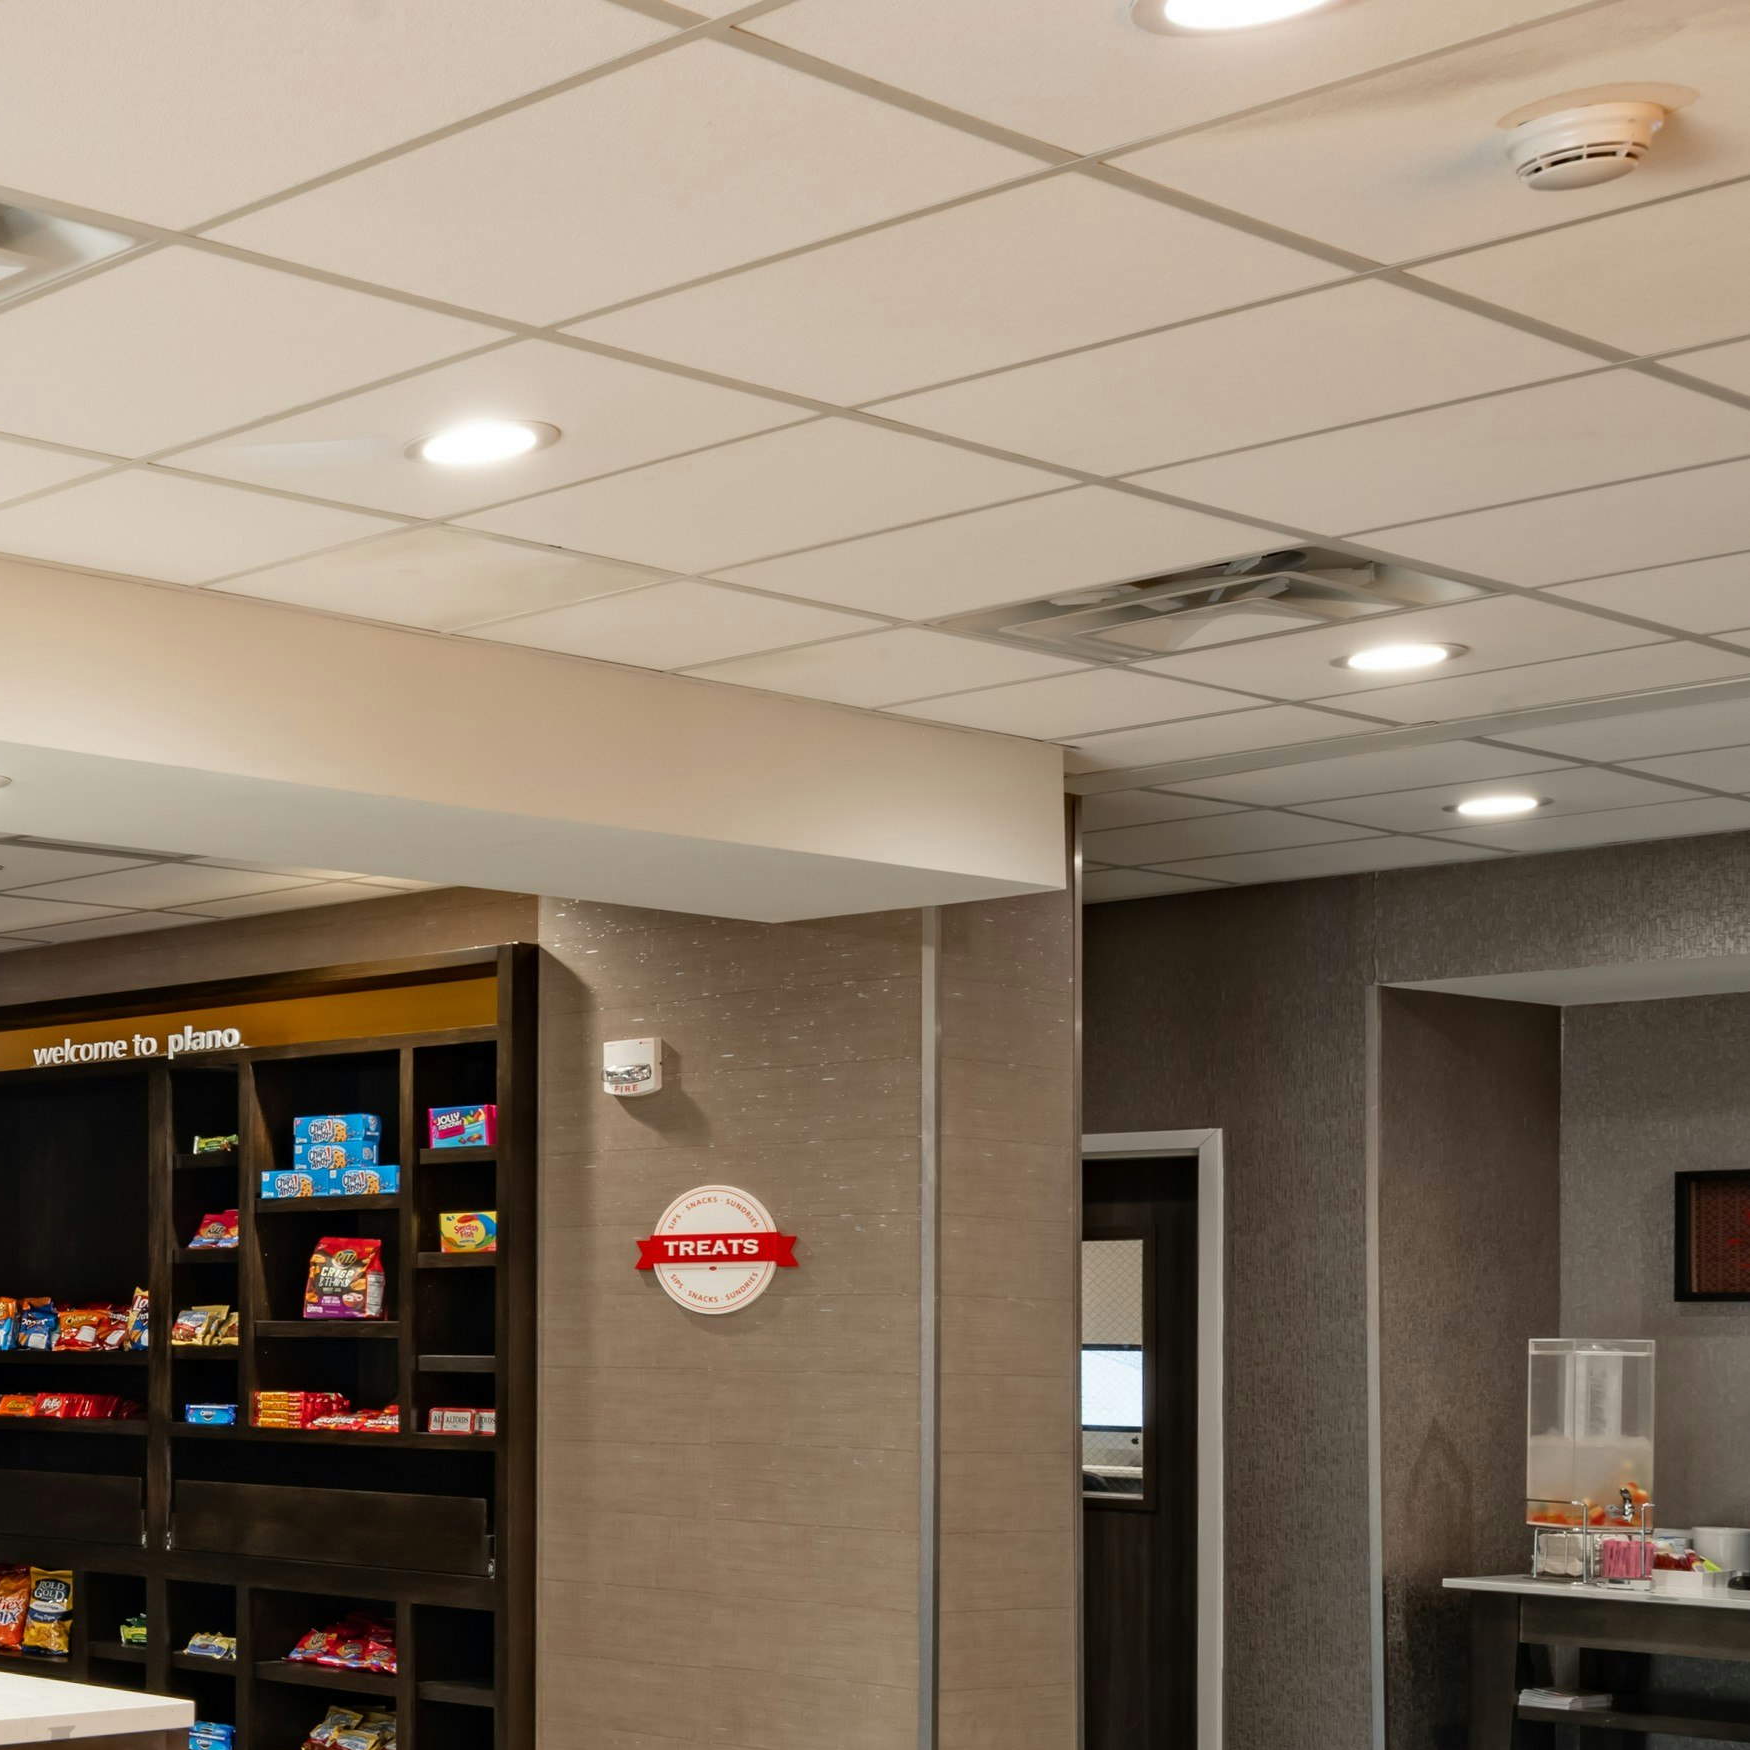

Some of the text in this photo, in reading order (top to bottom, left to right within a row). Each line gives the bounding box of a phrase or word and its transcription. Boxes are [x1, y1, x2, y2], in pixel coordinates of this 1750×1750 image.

[33, 1039, 127, 1066] welcome
[132, 1034, 158, 1056] to
[614, 1084, 638, 1092] FIRE
[437, 1112, 460, 1126] JOLLY
[668, 1196, 759, 1230] SIPS SNACKS SUNDRIES
[663, 1238, 759, 1256] TREATS
[321, 1266, 354, 1278] CRISP
[670, 1272, 758, 1303] SIPS SNACKS SUNDRIES
[446, 1416, 469, 1424] ALTOIDS
[39, 1580, 65, 1590] ROLD
[34, 1587, 65, 1601] GOLD
